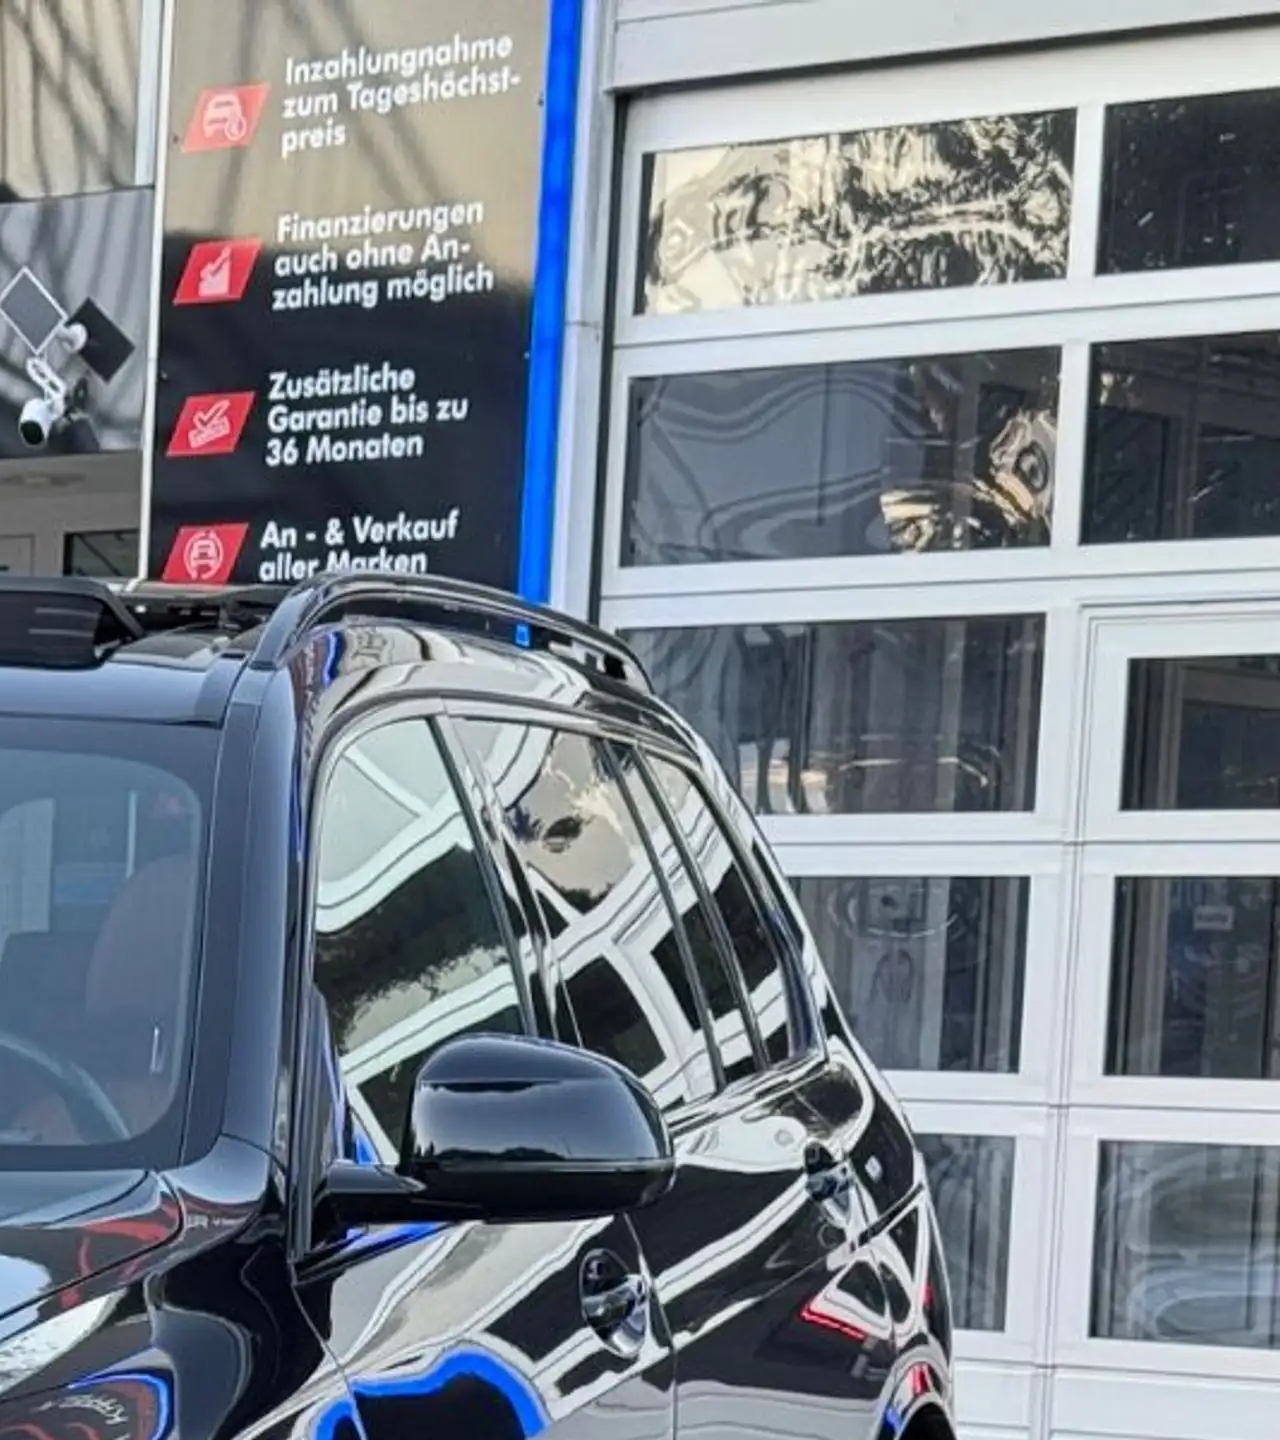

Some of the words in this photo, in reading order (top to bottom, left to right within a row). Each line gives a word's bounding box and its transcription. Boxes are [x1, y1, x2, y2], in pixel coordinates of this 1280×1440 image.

[285, 32, 514, 86] Inzahlungnahme
[282, 91, 339, 118] zum
[346, 65, 521, 114] Tageshöchst-
[281, 117, 346, 160] preis
[277, 201, 484, 243] Finanzierungen
[274, 242, 338, 277] auch
[345, 239, 414, 271] ohne
[420, 233, 472, 264] An-
[272, 276, 379, 311] zahlung
[386, 261, 495, 302] möglich
[268, 361, 416, 401] Zusätzliche
[267, 396, 383, 433] Garantie
[389, 392, 429, 424] bis
[435, 398, 469, 422] zu
[265, 437, 299, 468] 36
[305, 431, 424, 465] Monaten
[259, 520, 297, 549] An
[324, 517, 345, 546] &
[352, 507, 460, 544] Verkauf
[259, 551, 320, 582] aller
[325, 546, 428, 574] Marken
